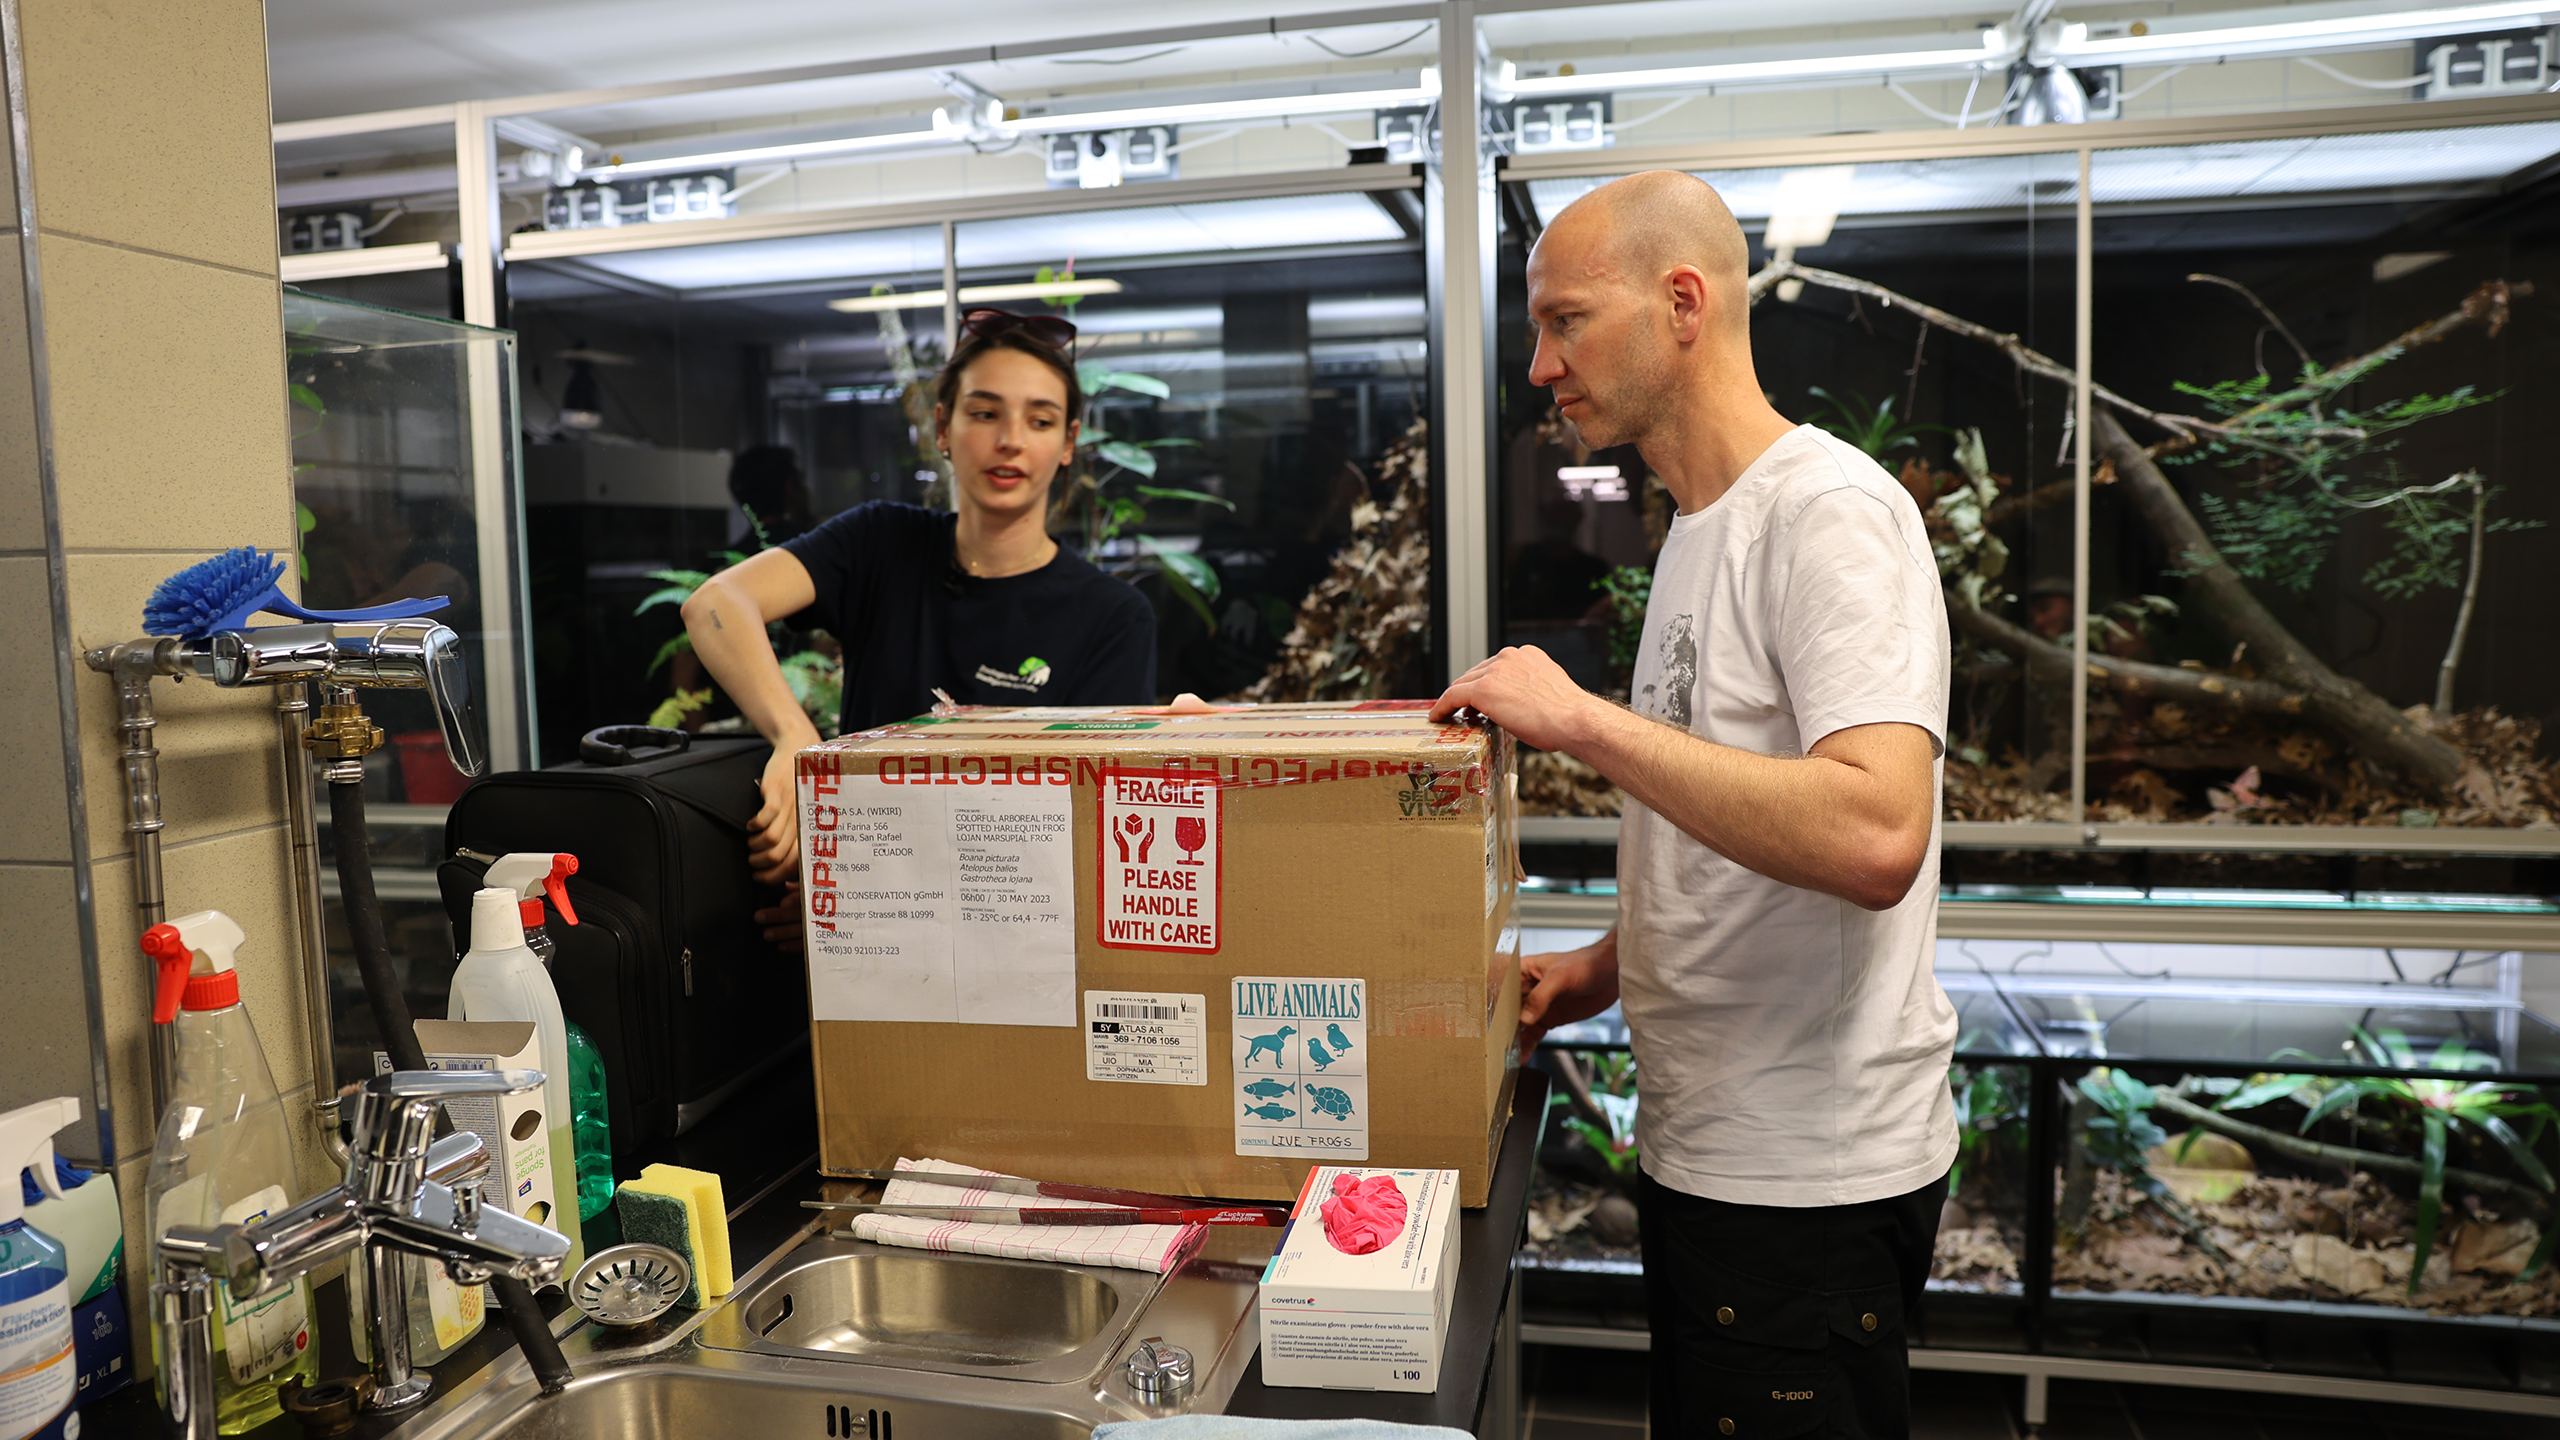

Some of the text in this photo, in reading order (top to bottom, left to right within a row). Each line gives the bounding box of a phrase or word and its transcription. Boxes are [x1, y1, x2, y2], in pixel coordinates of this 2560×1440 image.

[878, 756, 1121, 786] INSPECTED
[1116, 779, 1205, 805] FRAGILE
[849, 807, 866, 816] S.A.
[867, 807, 903, 818] (WIKIRI)
[955, 813, 1066, 823] COLORFUL ARBOREAL FROG
[846, 822, 872, 832] Farina
[873, 822, 889, 831] 566
[956, 823, 1066, 834] SPOTTED HARLEQUIN FROG
[859, 833, 875, 842] San
[876, 832, 903, 842] Rafael
[956, 833, 1054, 843] LOJAN MARSUPIAL FROG
[873, 847, 914, 857] ECUADOR
[959, 853, 1021, 864] Boana picturata
[827, 863, 833, 872] 2
[834, 863, 850, 872] 286
[851, 863, 870, 873] 9688
[959, 863, 1019, 874] Atelopus balios
[960, 873, 1034, 886] Gastrotheca lojana
[1124, 868, 1197, 891] PLEASE
[846, 890, 911, 900] CONSERVATION
[913, 890, 944, 902] gGmbH
[960, 892, 1052, 904] 06h00 / 30 MAY 2023
[1122, 894, 1198, 917] HANDLE
[868, 911, 896, 920] Strasse
[897, 910, 908, 920] 88
[910, 910, 935, 919] 10999
[961, 912, 972, 921] 18
[1001, 915, 1010, 923] or
[1012, 914, 1032, 925] 64,4
[815, 930, 854, 940] GERMANY
[1108, 919, 1212, 945] WITH CARE
[854, 946, 901, 955] 921013-223
[1236, 982, 1361, 1019] LIVE ANIMALS
[1100, 1024, 1165, 1034] 5Y ATLAS AIR
[1113, 1035, 1130, 1044] 369
[1136, 1036, 1158, 1045] 7106
[1159, 1037, 1181, 1046] 1056
[1102, 1057, 1118, 1065] UIO
[1138, 1059, 1154, 1067] MIA
[1271, 1135, 1353, 1148] LIVE FROGS
[534, 1146, 546, 1158] for
[514, 1151, 533, 1170] pans
[516, 1158, 545, 1181] Sponge
[1271, 1296, 1307, 1305] covetrus
[1270, 1319, 1290, 1327] Nitrile
[1290, 1320, 1327, 1328] examination
[1328, 1321, 1347, 1329] gloves
[1350, 1322, 1388, 1330] powder-free
[1393, 1370, 1421, 1381] L 100
[1771, 1390, 1814, 1401] G-1000
